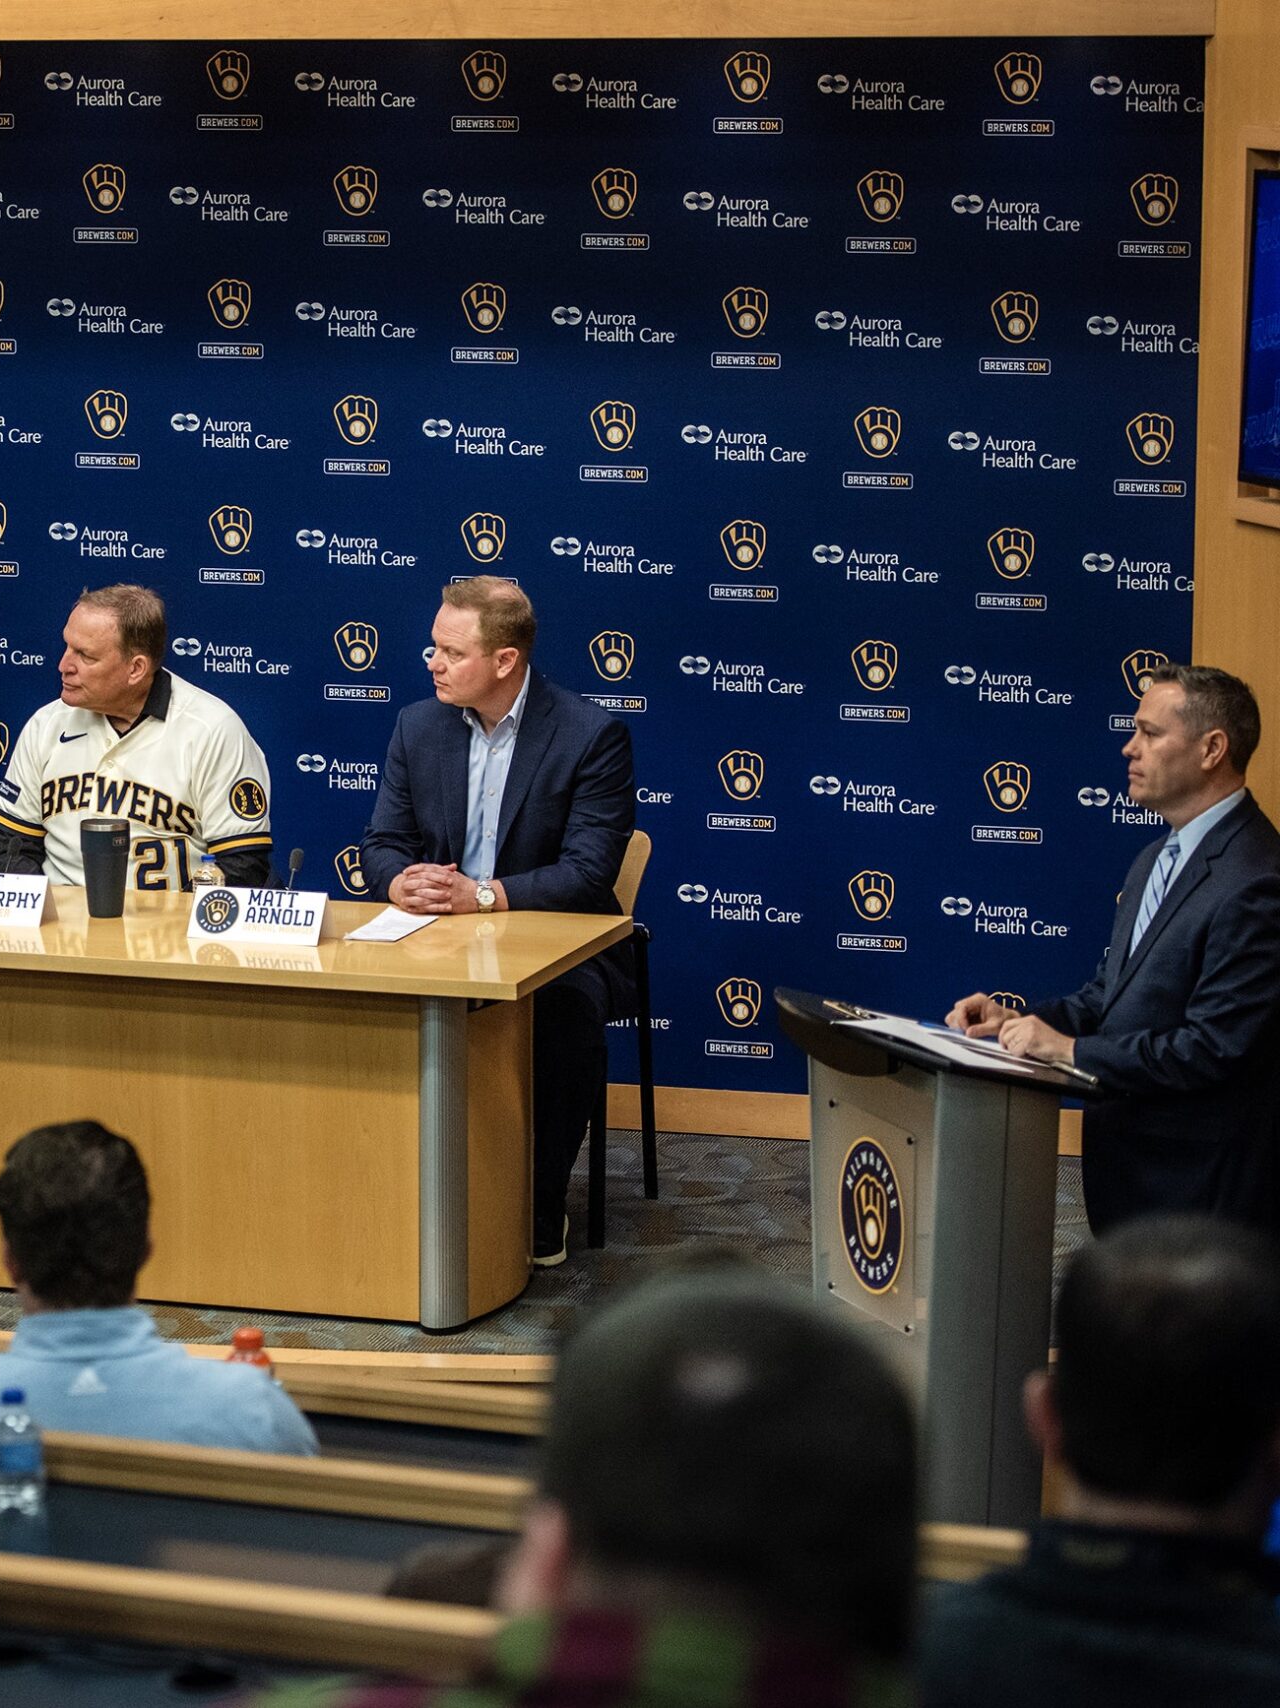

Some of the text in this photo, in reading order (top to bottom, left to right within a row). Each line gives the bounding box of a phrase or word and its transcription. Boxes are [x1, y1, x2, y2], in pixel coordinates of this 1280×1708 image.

[77, 75, 126, 90] Aurora
[586, 76, 638, 92] Aurora
[1126, 78, 1182, 94] Aurora
[76, 90, 162, 107] Health Care
[585, 92, 676, 110] Health Care
[1126, 94, 1204, 113] Health Ca
[455, 119, 515, 129] BREWERS.COM
[987, 122, 1051, 133] BREWERS.COM
[455, 192, 506, 208] Aurora
[986, 197, 1041, 214] Aurora
[6, 204, 40, 220] Care
[455, 208, 544, 226] Health Care
[986, 213, 1081, 232] Health Care
[77, 231, 135, 241] BREWERS.COM
[584, 237, 645, 247] BREWERS.COM
[1123, 243, 1187, 254] BREWERS.COM
[328, 306, 378, 322] Aurora
[849, 314, 903, 331] Aurora
[327, 321, 415, 339] Health Care
[848, 330, 942, 349] Health Care
[455, 351, 514, 361] BREWERS.COM
[715, 356, 776, 366] BREWERS.COM
[203, 417, 252, 433] Aurora
[203, 432, 289, 451] Health Care
[715, 429, 767, 445] Aurora
[79, 456, 136, 467] BREWERS.COM
[714, 444, 806, 463] Health Care
[583, 469, 643, 480] BREWERS.COM
[1118, 482, 1182, 494] BREWERS.COM
[80, 526, 129, 542] Aurora
[80, 541, 165, 560] Health Care
[583, 541, 635, 557] Aurora
[583, 556, 673, 576] Health Care
[1117, 556, 1172, 574] Aurora
[203, 571, 261, 582] BREWERS.COM
[1117, 572, 1194, 592] Health Ca
[980, 596, 1043, 608] BREWERS.COM
[10, 650, 44, 666] Care
[713, 660, 765, 677] Aurora
[328, 687, 386, 699] BREWERS.COM
[712, 675, 804, 695] Health Care
[844, 707, 906, 719] BREWERS.COM
[329, 758, 378, 775] Aurora
[328, 773, 376, 791] Health
[844, 780, 896, 797] Aurora
[41, 772, 196, 836] BREWERS
[843, 795, 935, 816] Health Care
[976, 828, 1039, 841] BREWERS.COM
[134, 837, 193, 893] 21
[248, 889, 299, 908] MATT
[245, 907, 315, 927] ARNOLD
[975, 901, 1029, 919] Aurora
[975, 916, 1068, 938] Health Care
[846, 1151, 897, 1209] MILWAUKEE
[848, 1234, 894, 1280] BREWERS
